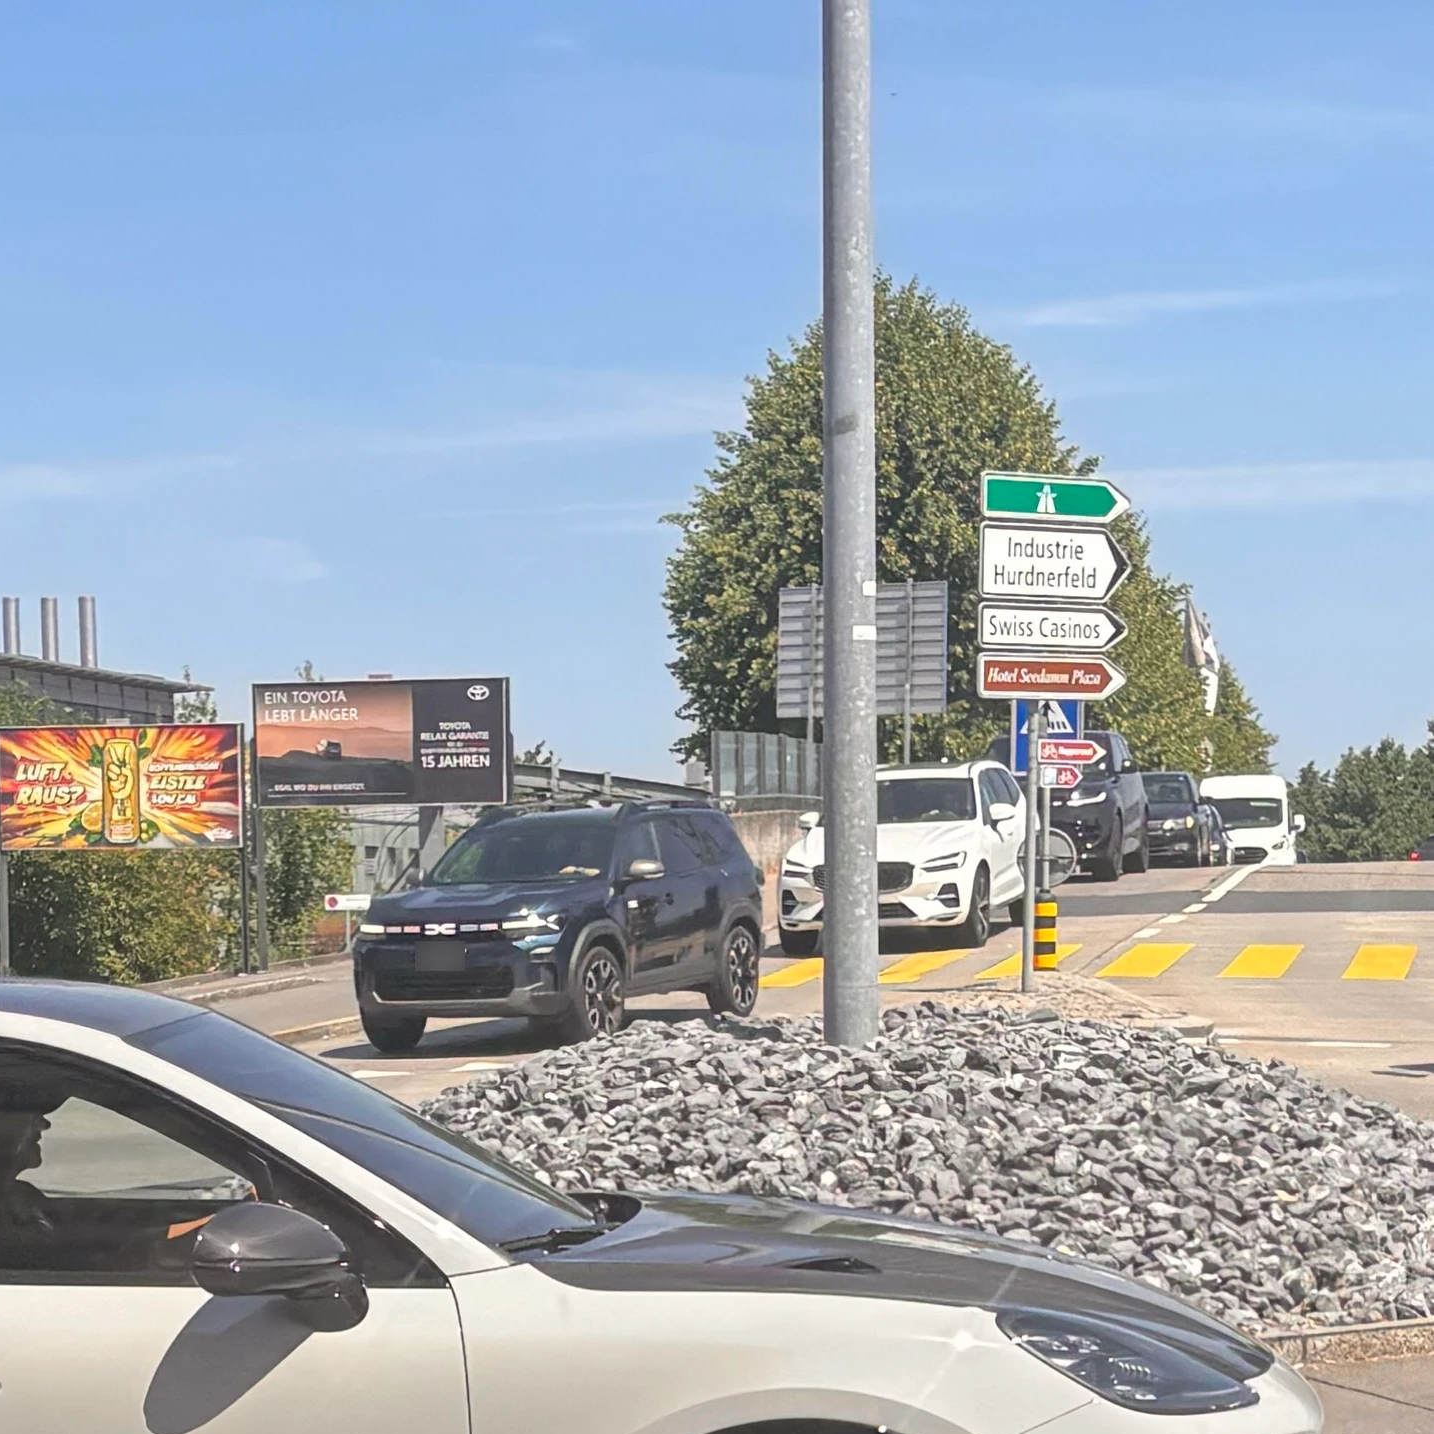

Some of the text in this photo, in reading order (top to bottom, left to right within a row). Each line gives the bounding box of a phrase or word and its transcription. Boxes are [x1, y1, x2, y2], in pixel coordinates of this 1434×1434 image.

[1007, 536, 1085, 561] Industrie
[994, 564, 1097, 589] Hurdnerfeld
[989, 614, 1101, 639] Swiss Casinos
[987, 667, 1018, 684] Hotel
[1071, 669, 1101, 686] Plaza
[264, 690, 347, 705] EIN TOYOTA
[265, 706, 359, 724] LEBT LÄNGER
[439, 721, 471, 730] TOYOTA
[421, 754, 490, 768] 15 JAHREN
[16, 761, 66, 783] LUFT
[16, 784, 85, 807] RAUS?
